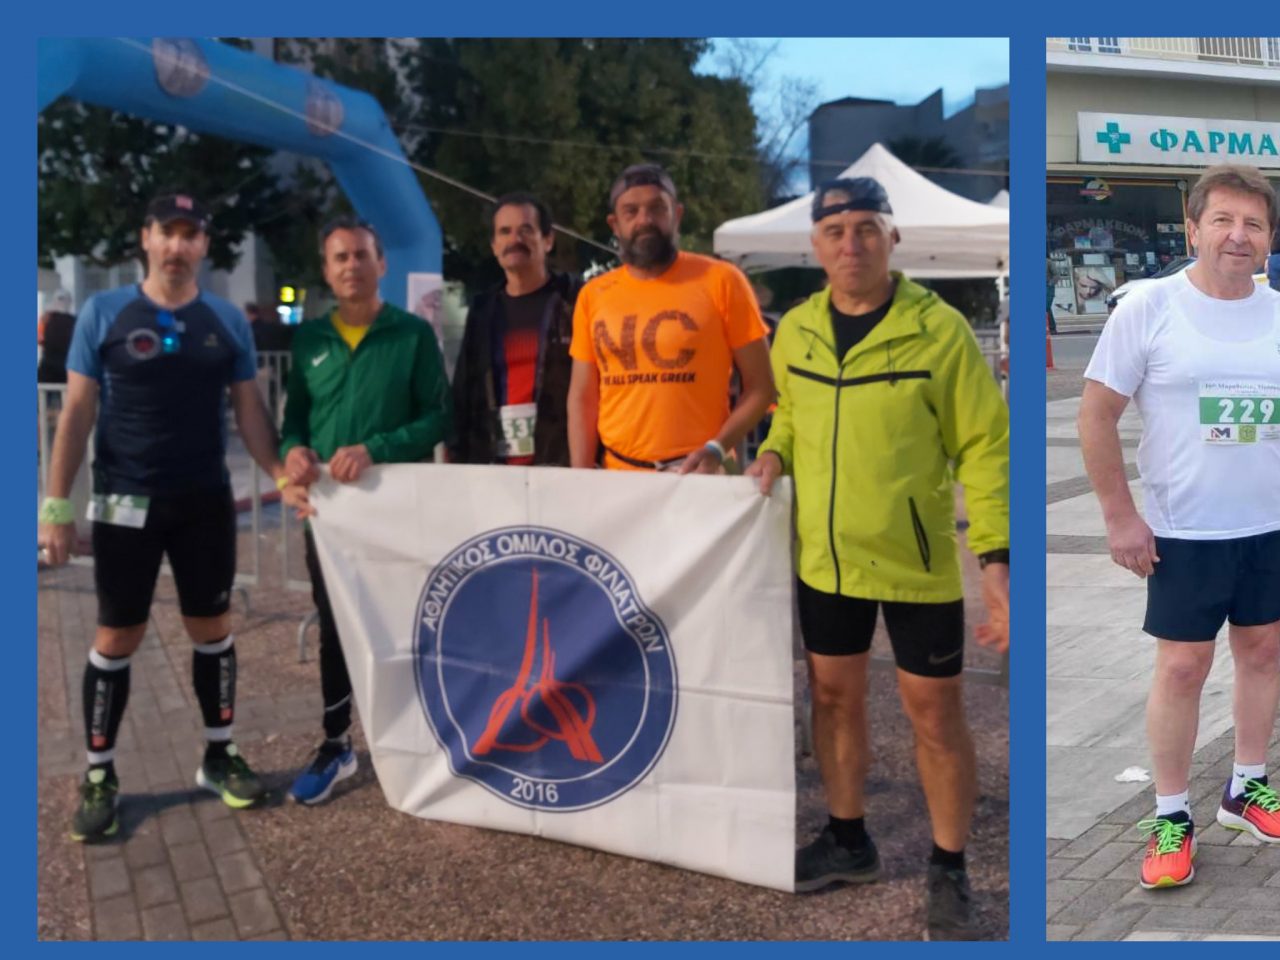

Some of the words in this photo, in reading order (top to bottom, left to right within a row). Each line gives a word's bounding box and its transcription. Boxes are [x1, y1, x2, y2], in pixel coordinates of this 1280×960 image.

[594, 310, 699, 372] NC
[627, 373, 657, 385] SPEAK
[660, 371, 696, 383] GREEK
[1218, 398, 1275, 423] 229
[422, 540, 495, 631] ΑΘΛΗΤΙΚΟΣ
[496, 534, 581, 563] ΟΜΙΛΟΣ
[584, 554, 664, 653] ΦΙΛΙΑΤΡΩΝ
[510, 778, 559, 803] 2016
